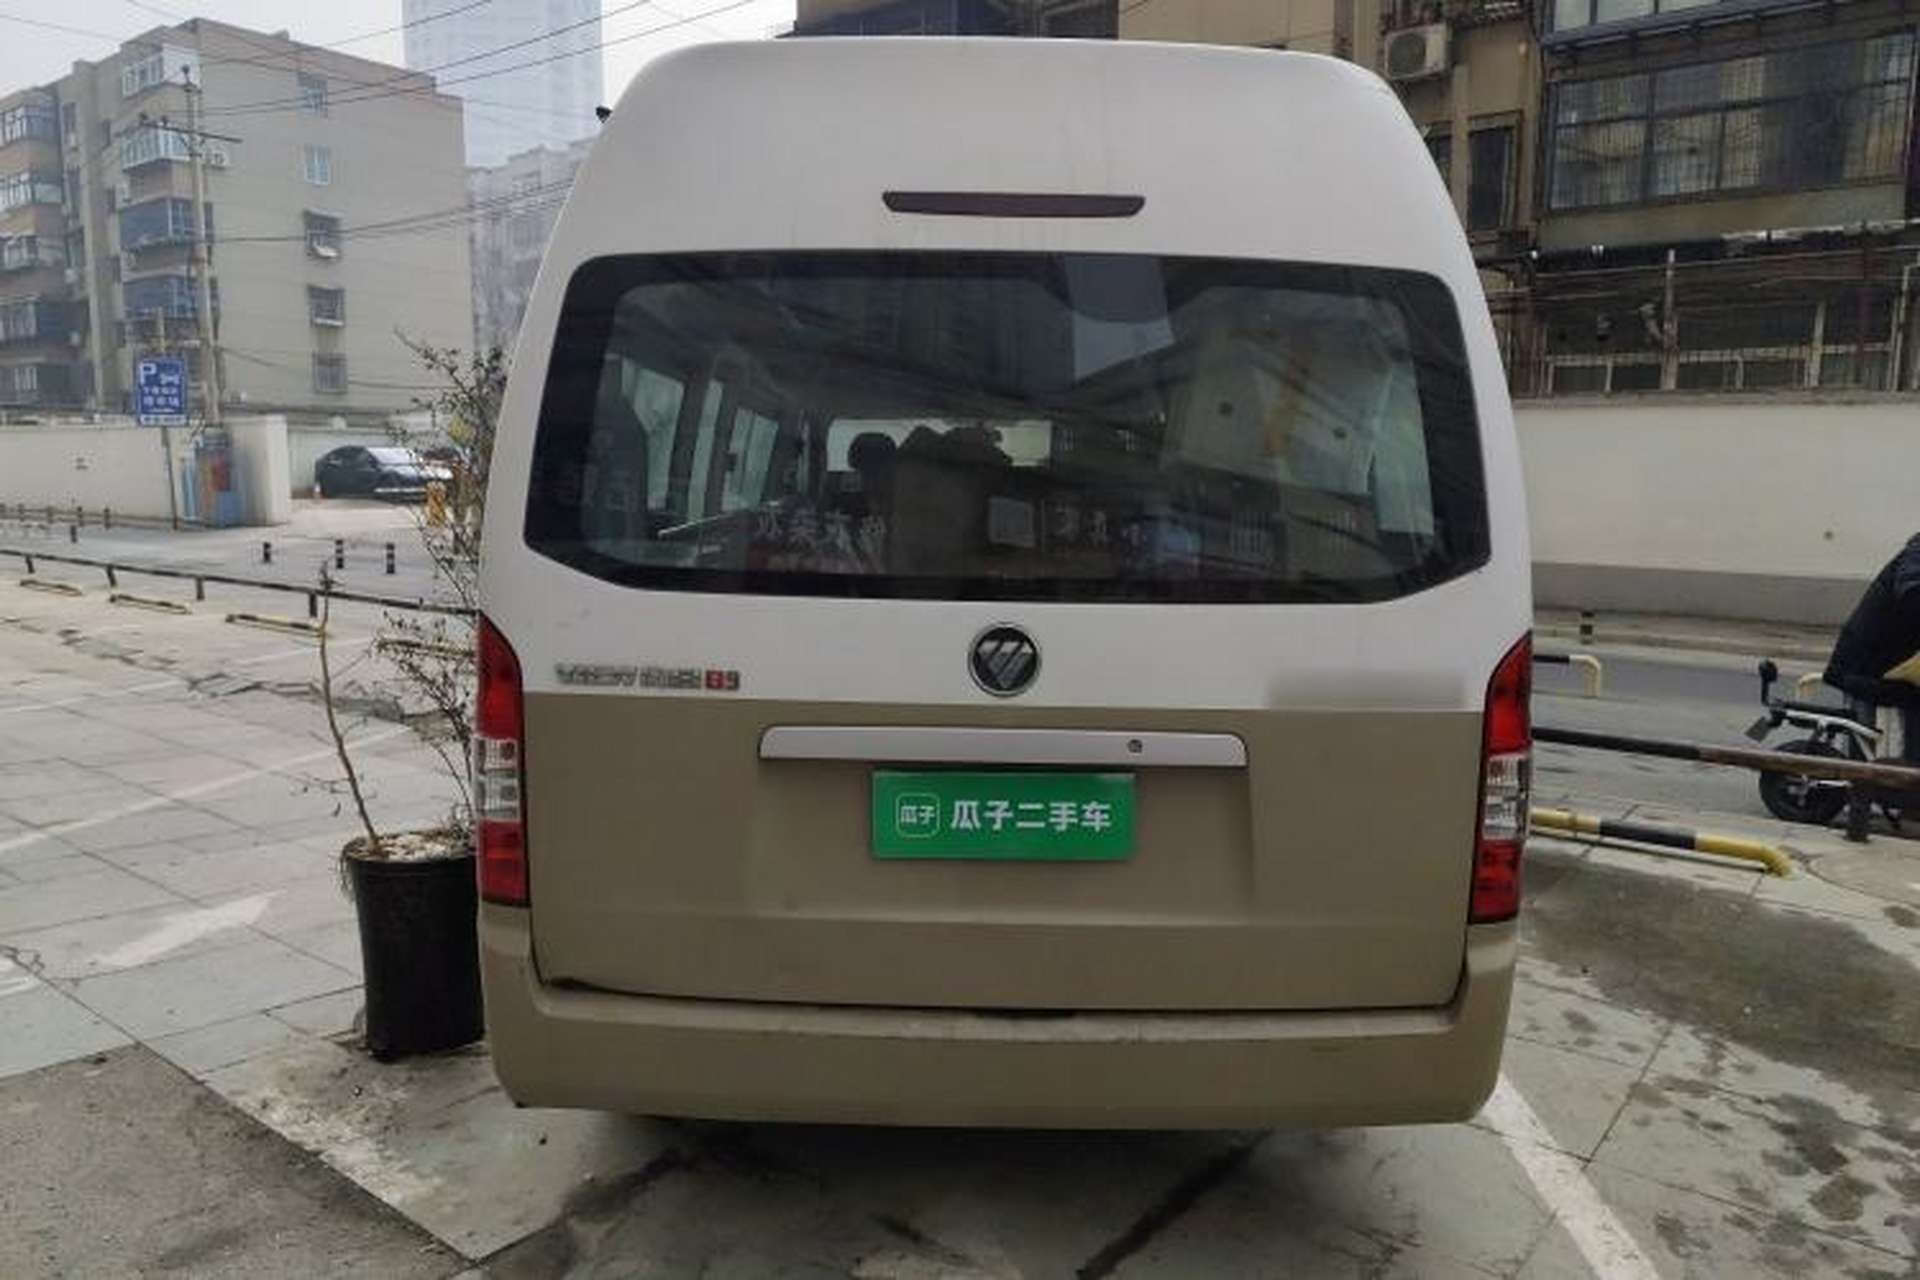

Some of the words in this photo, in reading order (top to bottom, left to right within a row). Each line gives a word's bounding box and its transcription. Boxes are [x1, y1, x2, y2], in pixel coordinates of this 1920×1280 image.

[139, 363, 157, 386] P
[900, 804, 936, 825] 瓜子
[950, 800, 1113, 832] 瓜子二手车
